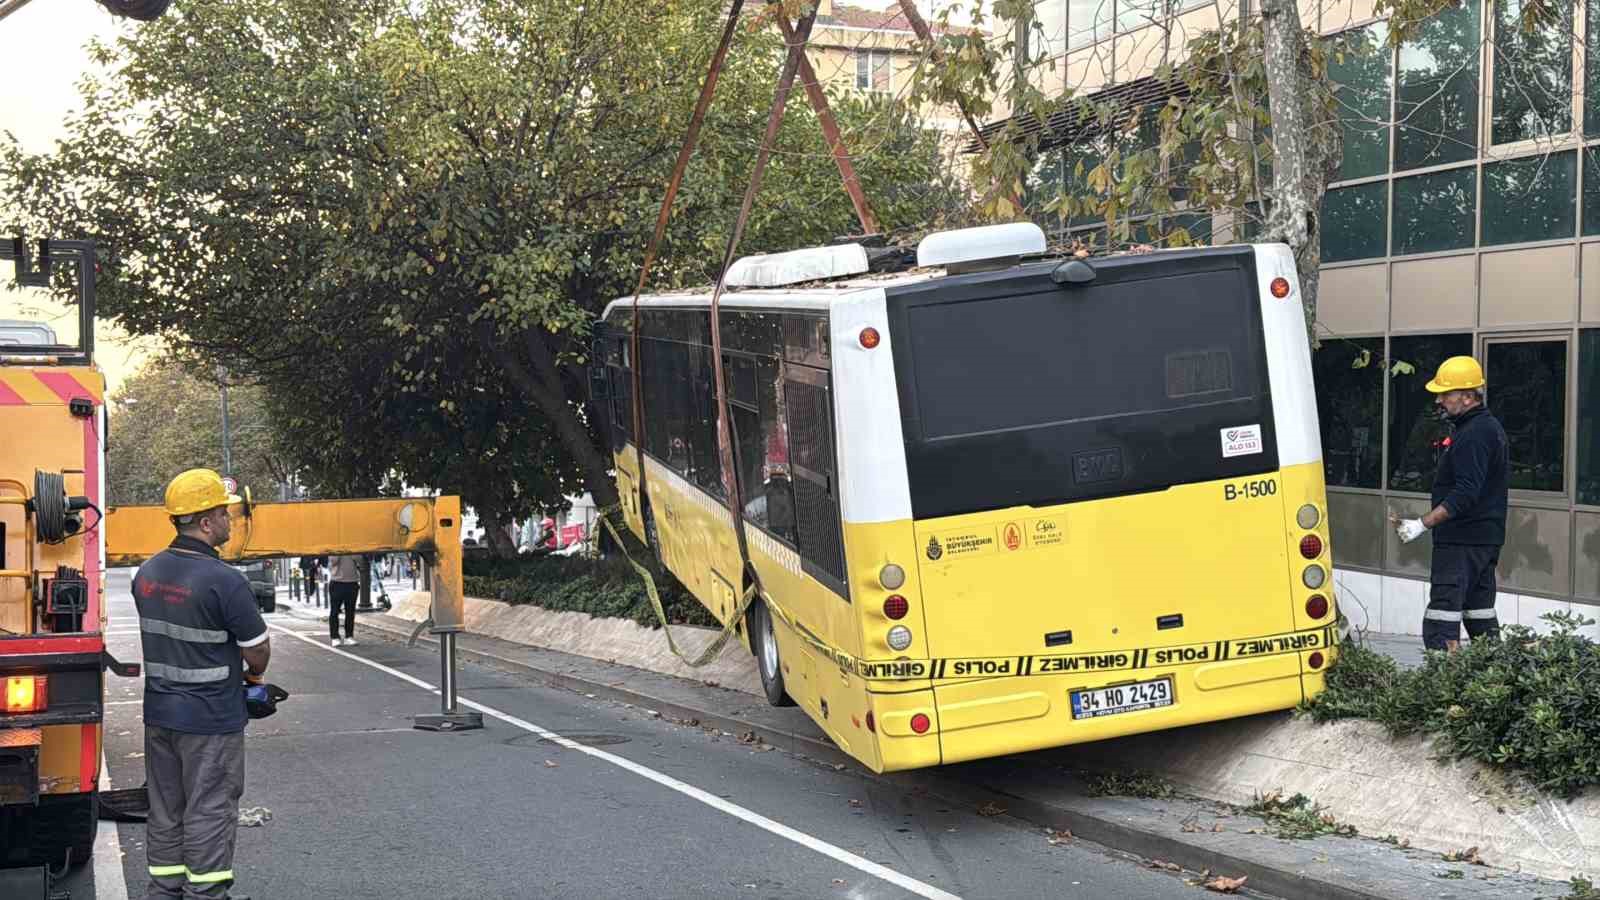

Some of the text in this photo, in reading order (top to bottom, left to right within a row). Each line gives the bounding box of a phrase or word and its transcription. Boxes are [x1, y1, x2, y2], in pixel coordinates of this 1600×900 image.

[1224, 479, 1277, 500] B-1500
[1081, 693, 1099, 710] 34
[1105, 689, 1124, 707] HO
[1130, 683, 1167, 703] 2429
